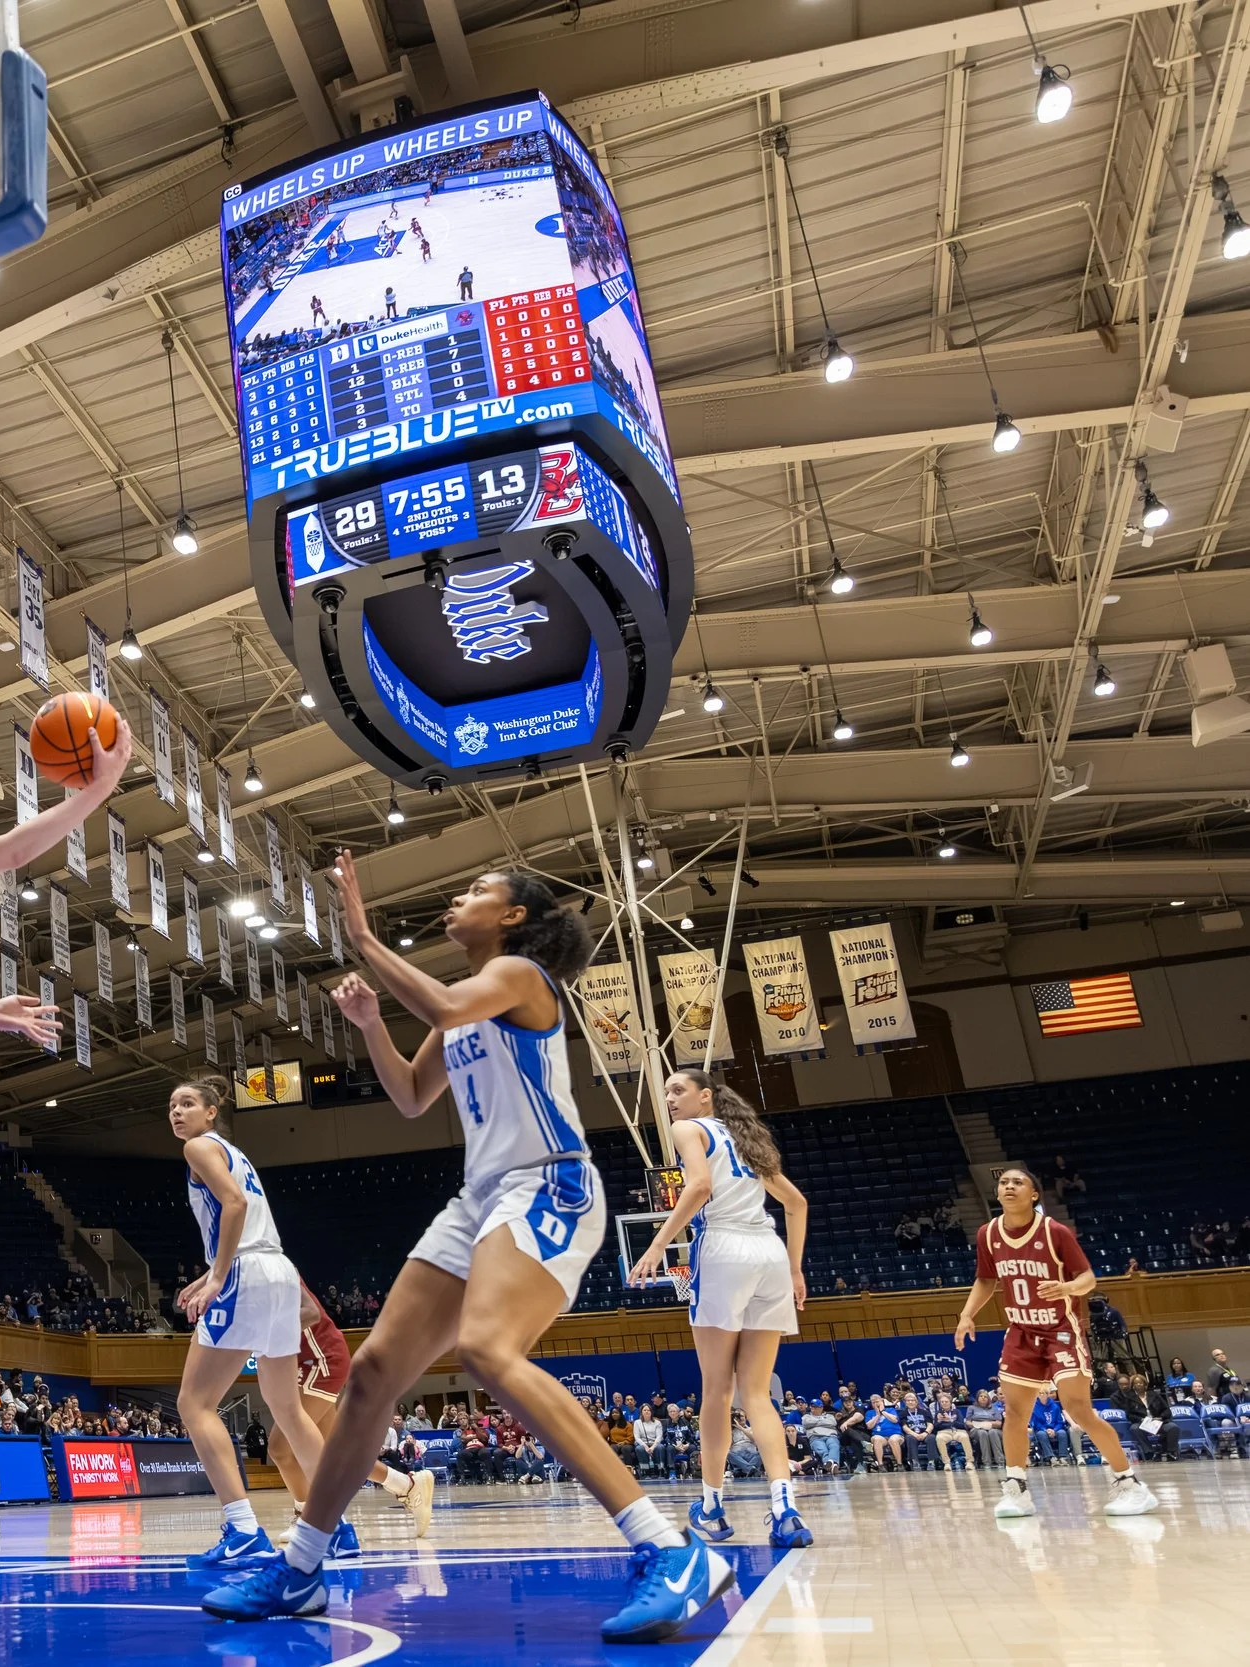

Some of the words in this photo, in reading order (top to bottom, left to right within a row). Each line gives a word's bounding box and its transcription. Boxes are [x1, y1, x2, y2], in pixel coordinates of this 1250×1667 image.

[232, 167, 325, 222] WHEELS
[332, 153, 365, 180] UP
[383, 118, 489, 163] WHEELS
[497, 110, 533, 132] UP
[225, 186, 241, 199] CC
[489, 300, 508, 311] PL
[511, 295, 529, 307] PTS
[534, 291, 551, 302] REB
[556, 286, 573, 298] FLS
[496, 316, 506, 326] 0
[518, 311, 528, 321] 0
[541, 307, 550, 317] 0
[563, 303, 572, 313] 0
[381, 320, 444, 345] DukeHealth
[351, 364, 360, 374] 1
[383, 345, 423, 364] O-REB
[448, 336, 457, 346] 1
[243, 374, 259, 388] PL
[262, 368, 276, 381] PTS
[280, 360, 295, 373] REB
[299, 354, 314, 366] FLS
[348, 375, 365, 389] 12
[385, 358, 425, 378] D-REB
[449, 349, 458, 359] 7
[354, 390, 363, 400] 1
[391, 373, 422, 390] BLK
[451, 362, 461, 373] 0
[356, 404, 365, 415] 2
[395, 388, 423, 404] STL
[453, 377, 463, 387] 0
[357, 418, 367, 429] 3
[401, 404, 421, 417] TO
[456, 391, 466, 401] 4
[271, 404, 478, 490] TRUEBLUE
[484, 400, 513, 419] TV
[516, 402, 574, 425] .com
[478, 465, 526, 500] 13
[388, 476, 465, 516] 7:55
[482, 498, 516, 512] Fouls:
[516, 496, 524, 505] 1
[335, 500, 377, 537] 29
[407, 511, 428, 523] 2ND
[431, 505, 453, 518] QTR
[392, 527, 400, 536] 4
[403, 514, 459, 534] TIMEOUTS
[463, 512, 470, 520] 3
[343, 535, 374, 550] Fouls:
[374, 533, 381, 542] 1
[419, 527, 446, 540] POSS
[25, 595, 44, 631] 35
[442, 559, 549, 664] Duke
[492, 714, 551, 732] Washington
[552, 707, 581, 720] Duke
[499, 732, 516, 742] Inn
[518, 730, 528, 739] &
[528, 723, 552, 736] Golf
[552, 717, 578, 731] Club
[841, 938, 886, 954] NATIONAL
[754, 951, 797, 966] NATIONAL
[839, 949, 895, 966] CHAMPIONS
[669, 963, 710, 977] NATIONAL
[752, 962, 804, 978] CHAMPIONS
[586, 976, 627, 989] NATIONAL
[866, 972, 897, 987] FINAL
[584, 988, 630, 1001] CHAMPION
[773, 984, 803, 995] FINAL
[857, 981, 898, 1003] FOUR
[765, 994, 807, 1009] FOUR
[868, 1016, 897, 1029] 2015
[778, 1027, 806, 1039] 2010
[690, 1039, 716, 1050] 200
[606, 1050, 631, 1061] 1992
[313, 1074, 337, 1084] DUKE
[466, 1074, 484, 1126] 4
[725, 1139, 758, 1180] 1
[538, 1211, 567, 1246] D
[1012, 1278, 1030, 1306] 0
[209, 1309, 227, 1327] D
[567, 1385, 603, 1397] TERHOOD
[1103, 1410, 1123, 1419] DUKE
[1171, 1406, 1192, 1417] DUKE
[1206, 1403, 1227, 1415] DUKE
[69, 1454, 88, 1471] FAN
[88, 1454, 117, 1471] WORK
[140, 1462, 151, 1473] Over
[155, 1463, 168, 1473] Hotel
[167, 1462, 181, 1473] Brands
[187, 1462, 198, 1474] Every
[73, 1474, 80, 1484] IS
[79, 1473, 103, 1483] THIRSTY
[102, 1472, 119, 1483] WORK
